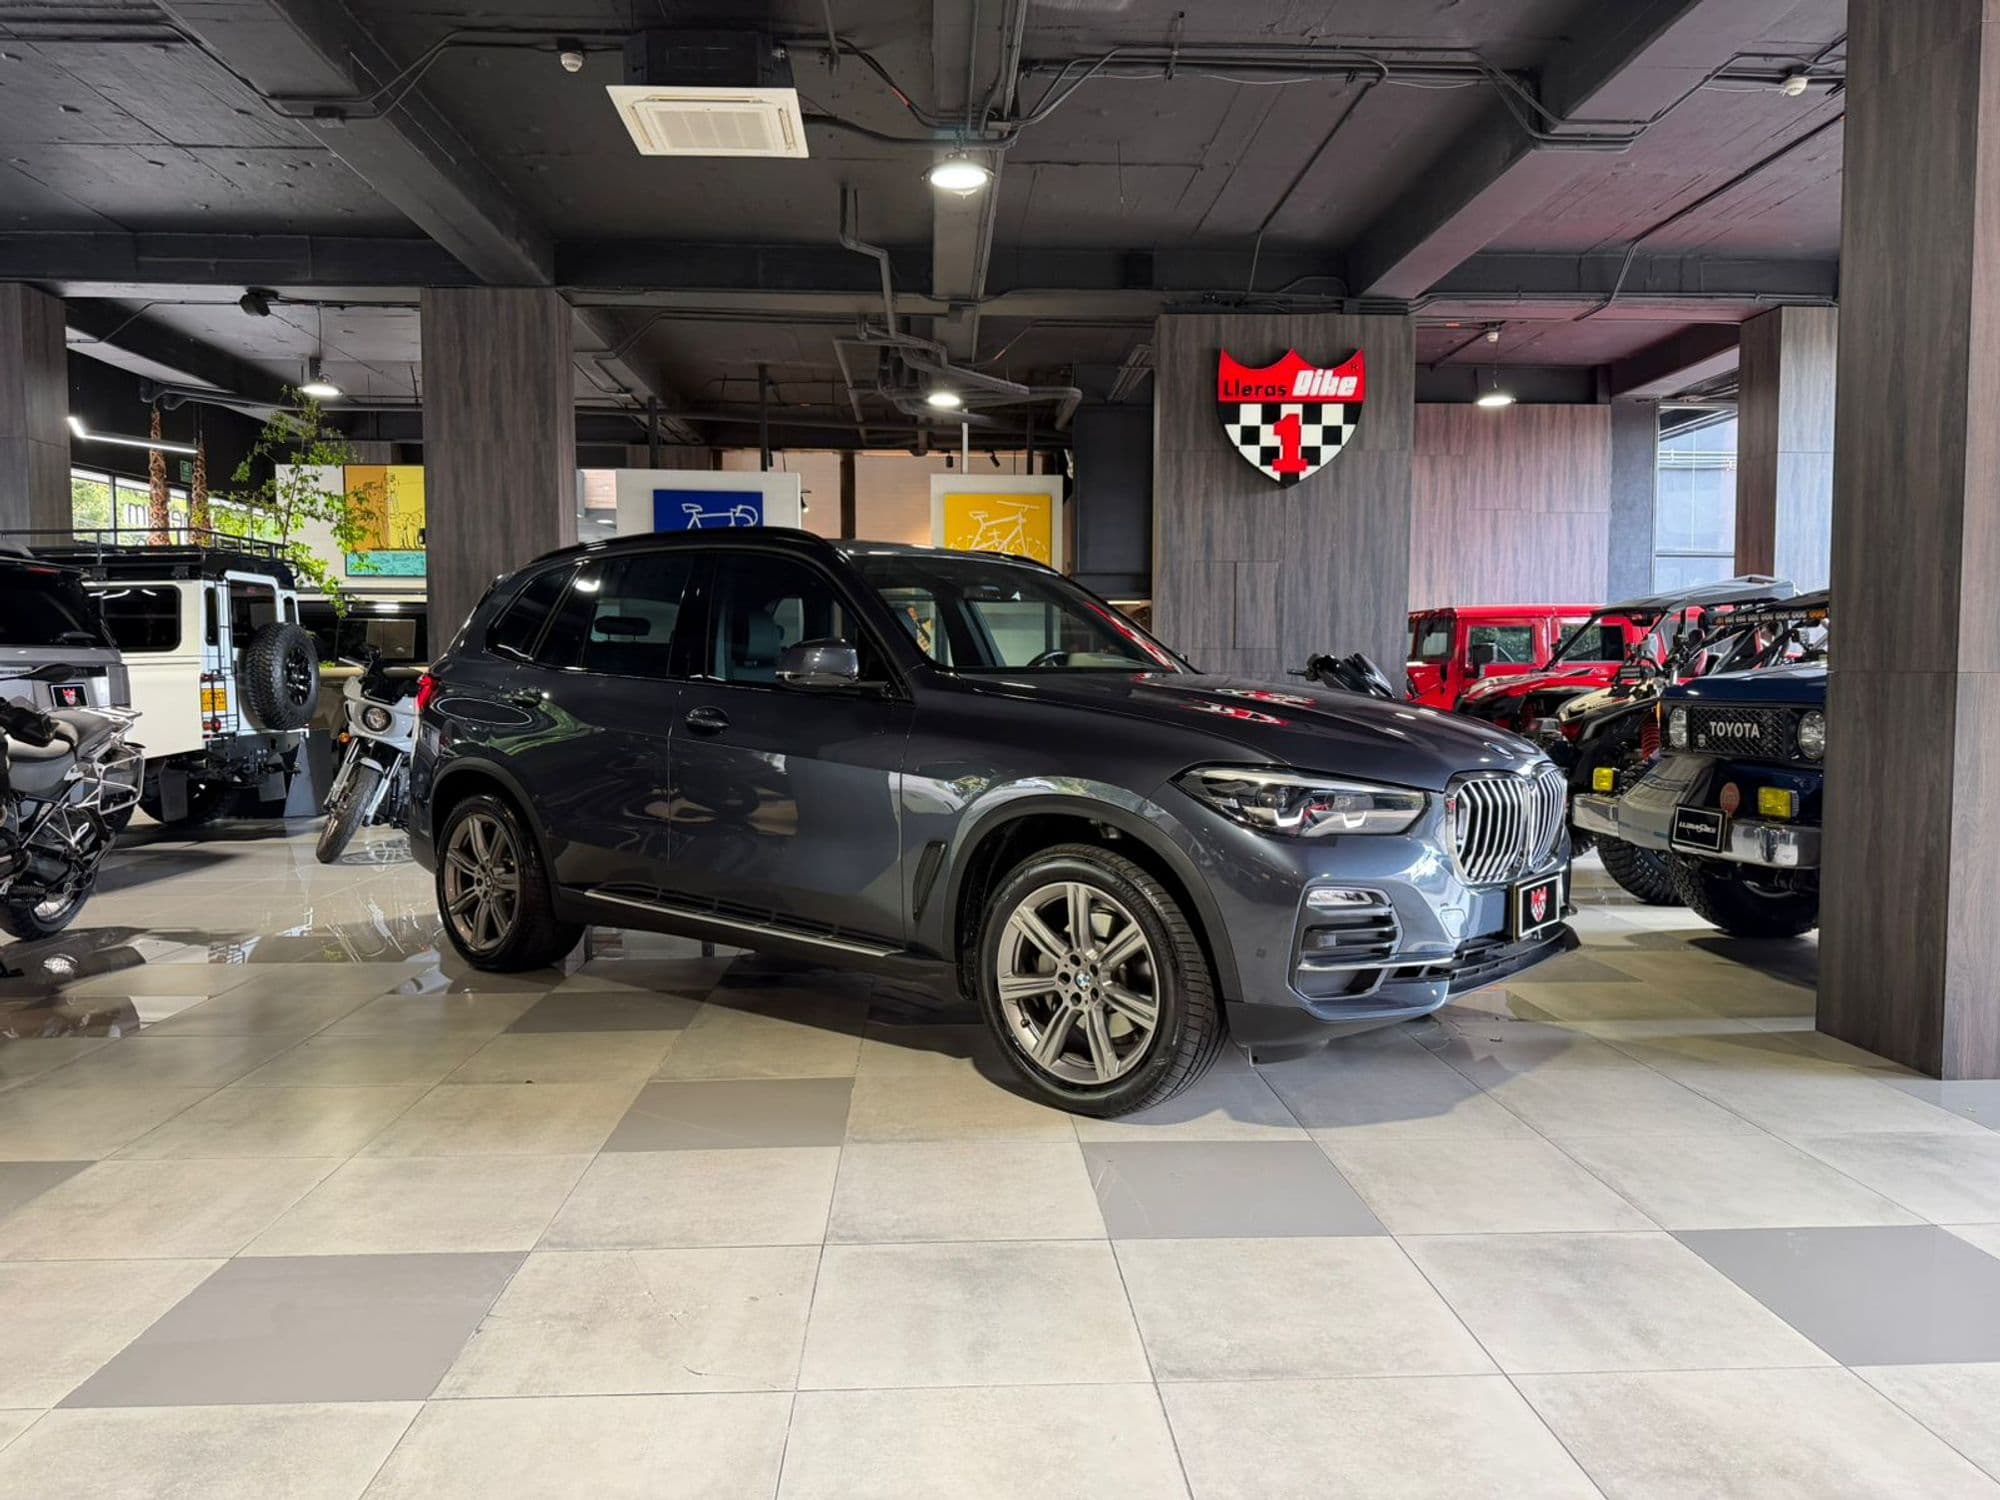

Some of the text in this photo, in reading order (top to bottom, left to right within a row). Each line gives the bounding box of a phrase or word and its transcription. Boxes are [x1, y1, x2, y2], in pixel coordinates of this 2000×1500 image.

[1223, 380, 1287, 397] Lleras
[1272, 413, 1308, 473] 1
[1709, 721, 1760, 738] TOYOTA
